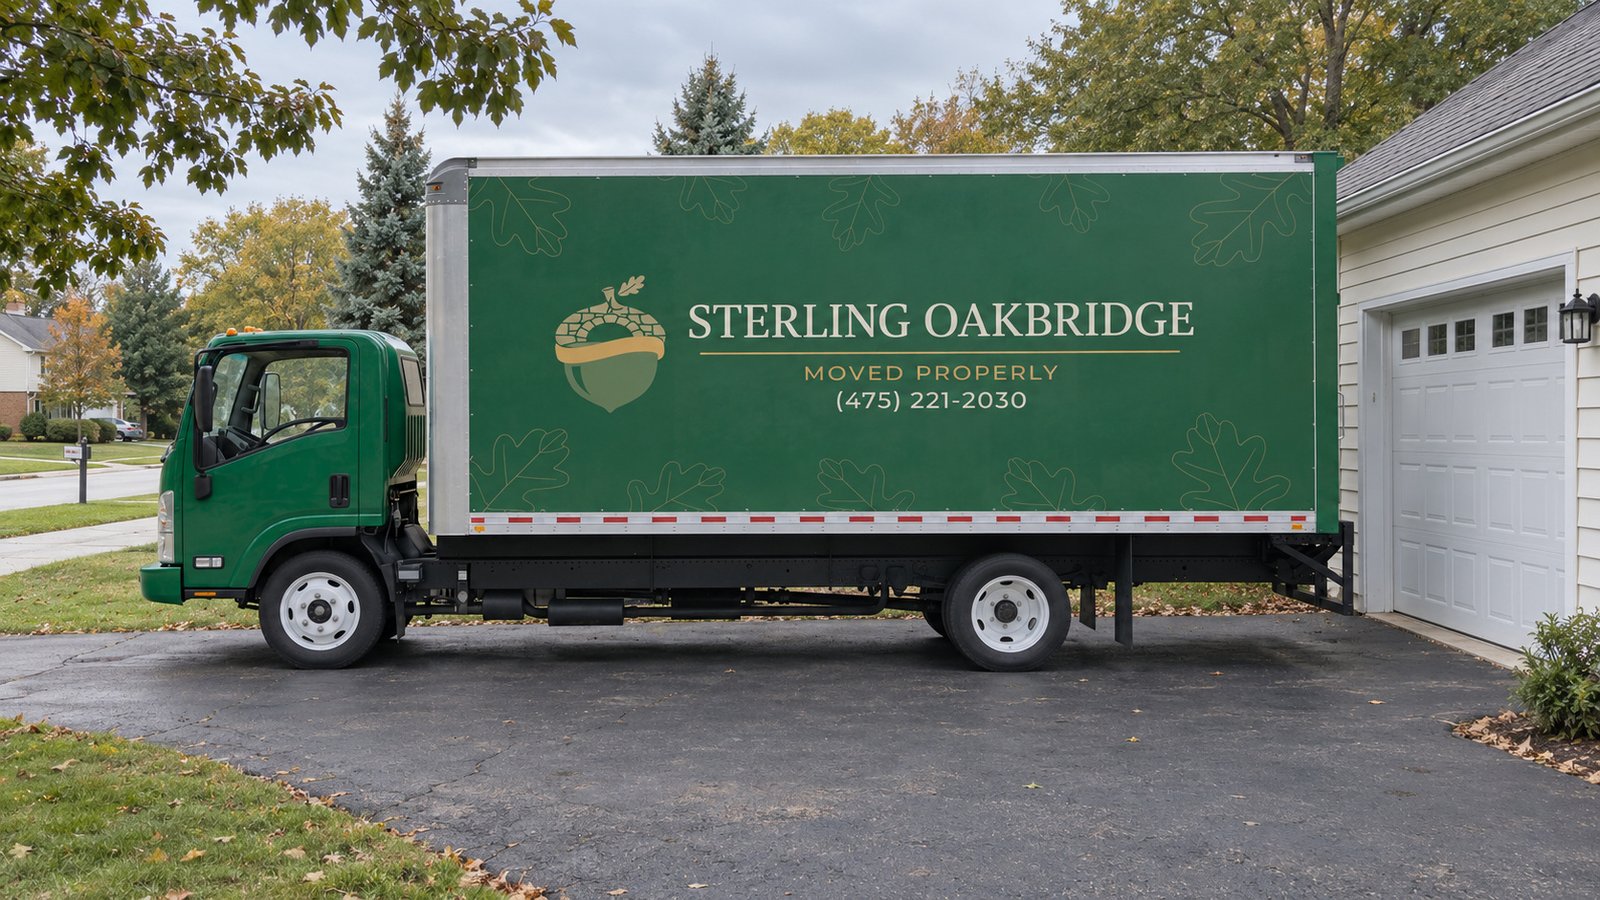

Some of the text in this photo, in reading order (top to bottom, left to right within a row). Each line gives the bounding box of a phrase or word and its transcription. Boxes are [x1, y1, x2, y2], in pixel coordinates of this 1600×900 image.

[688, 301, 1195, 339] STERLING OAKBRIDGE
[804, 365, 1058, 381] MOVED PROPERLY
[836, 390, 1027, 413] (475) 221-2030
